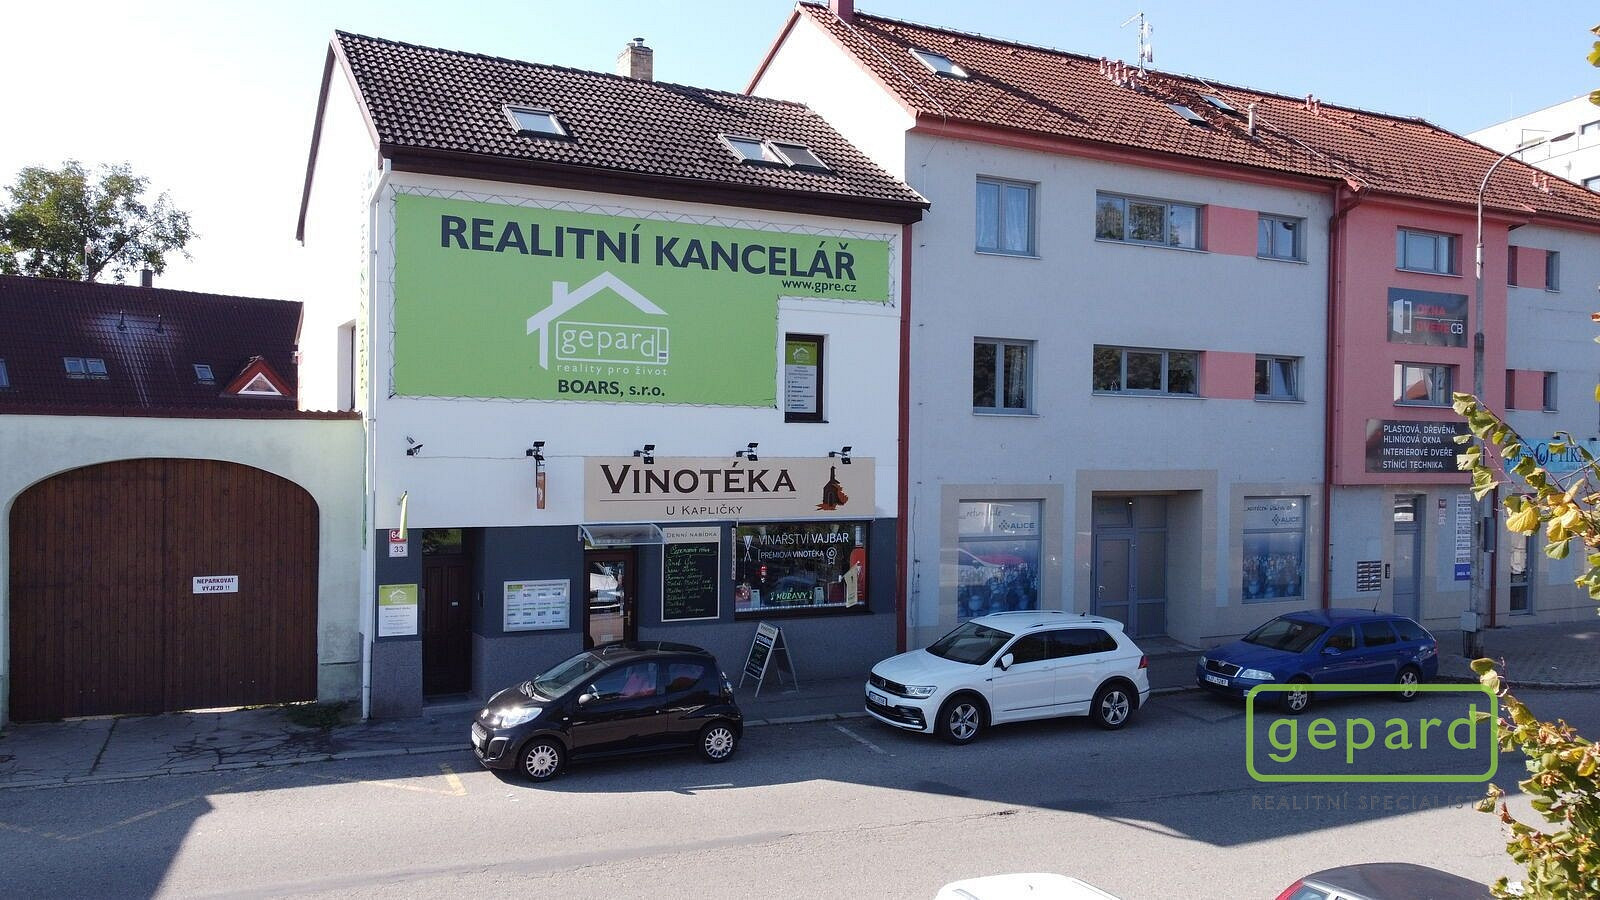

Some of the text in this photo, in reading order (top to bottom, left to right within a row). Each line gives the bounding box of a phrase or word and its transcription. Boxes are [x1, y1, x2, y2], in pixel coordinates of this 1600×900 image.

[441, 214, 857, 281] REALITNÍ KANCELÁŘ
[781, 279, 857, 294] www.gpre.cz
[1450, 323, 1463, 334] CB
[561, 329, 655, 357] gepard
[557, 363, 667, 376] reality pro život
[558, 379, 665, 397] BOARS, s.r.o.
[1383, 424, 1421, 434] PLASTOVÁ,
[1383, 434, 1441, 444] HLINÍKOVÁ OKNA
[1383, 446, 1453, 457] INTERIÉROVÉ DVEŘE
[1410, 460, 1443, 469] TECHNIKA
[600, 461, 797, 494] VINOTÉKA
[666, 503, 744, 516] U KAPLIČKY
[758, 532, 849, 545] VINAŘSTVÍ VAJBAR
[393, 545, 404, 553] 33
[792, 549, 824, 558] VINOTÉKA
